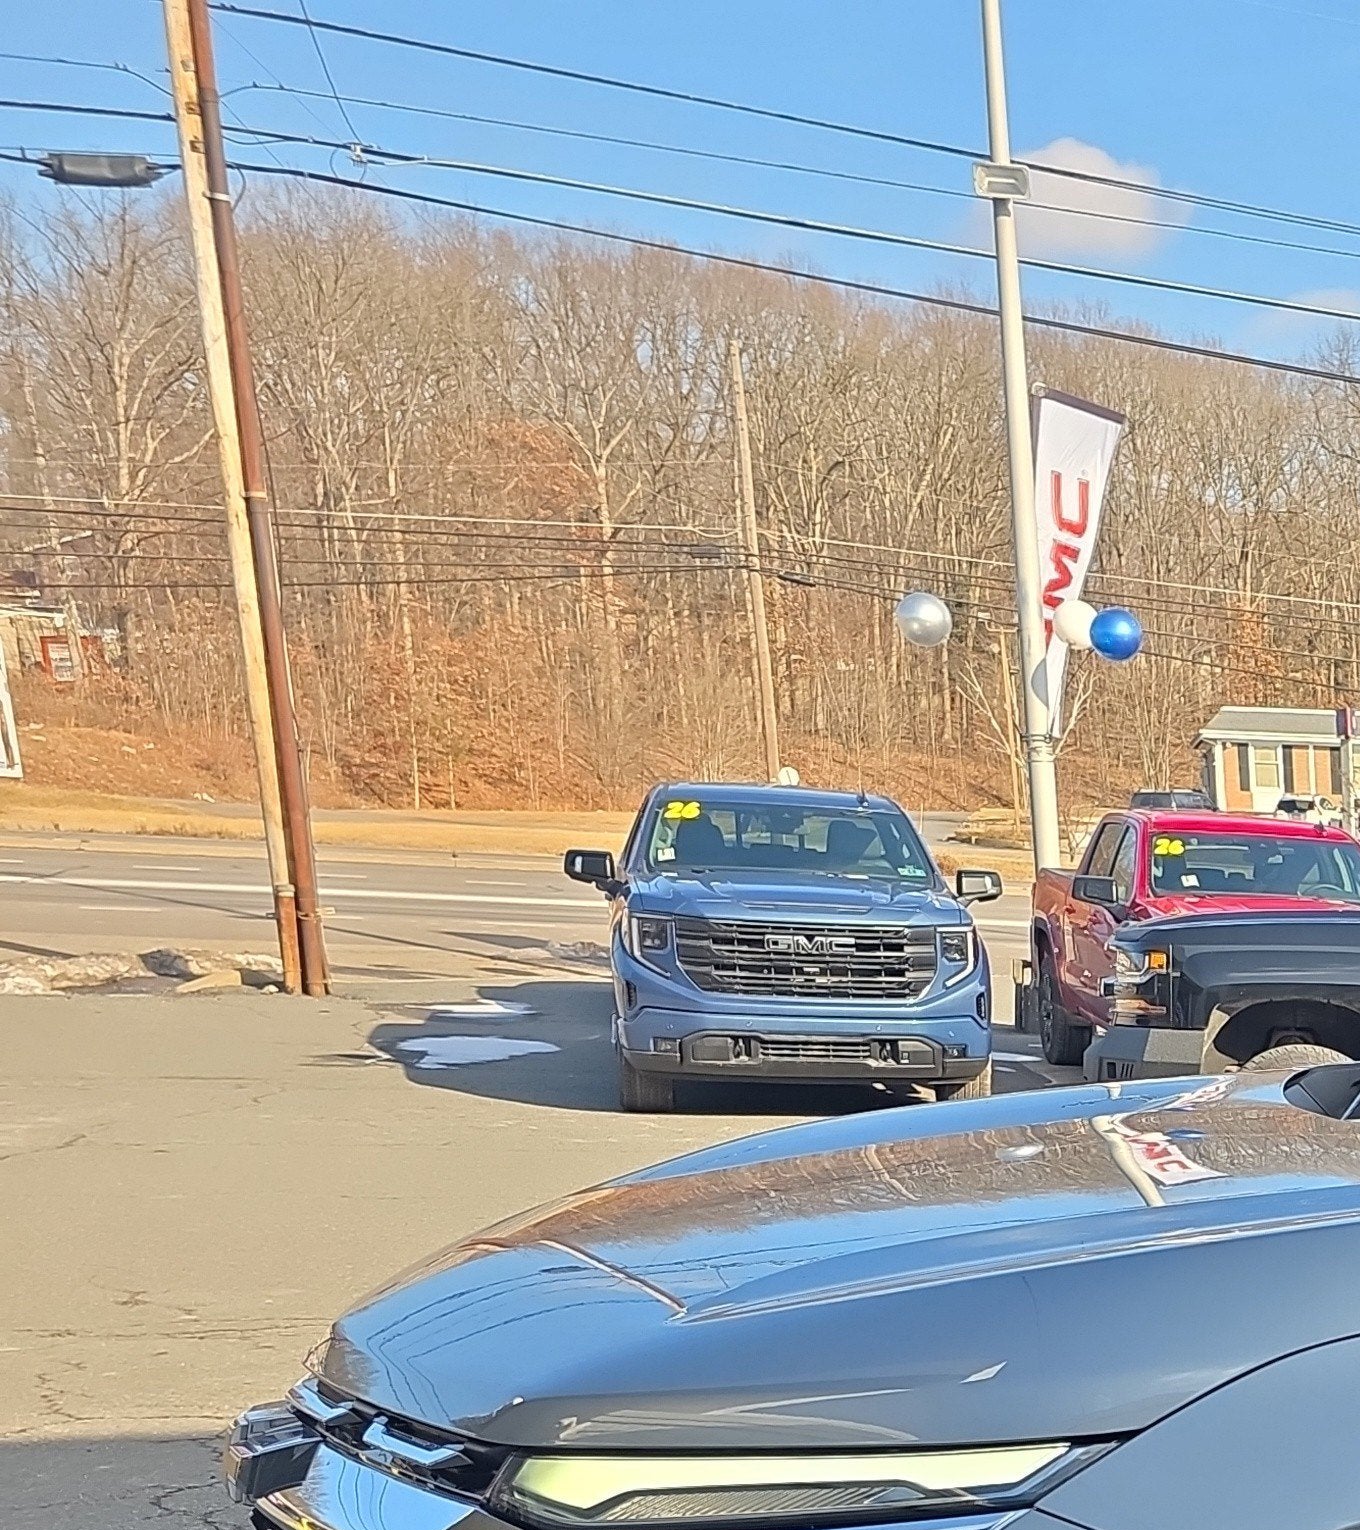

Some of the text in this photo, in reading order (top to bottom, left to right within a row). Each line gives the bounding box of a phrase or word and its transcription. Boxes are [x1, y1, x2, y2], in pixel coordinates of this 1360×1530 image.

[1043, 470, 1090, 650] MC
[663, 801, 700, 819] 26
[1154, 838, 1184, 855] 26
[764, 933, 856, 954] GMC
